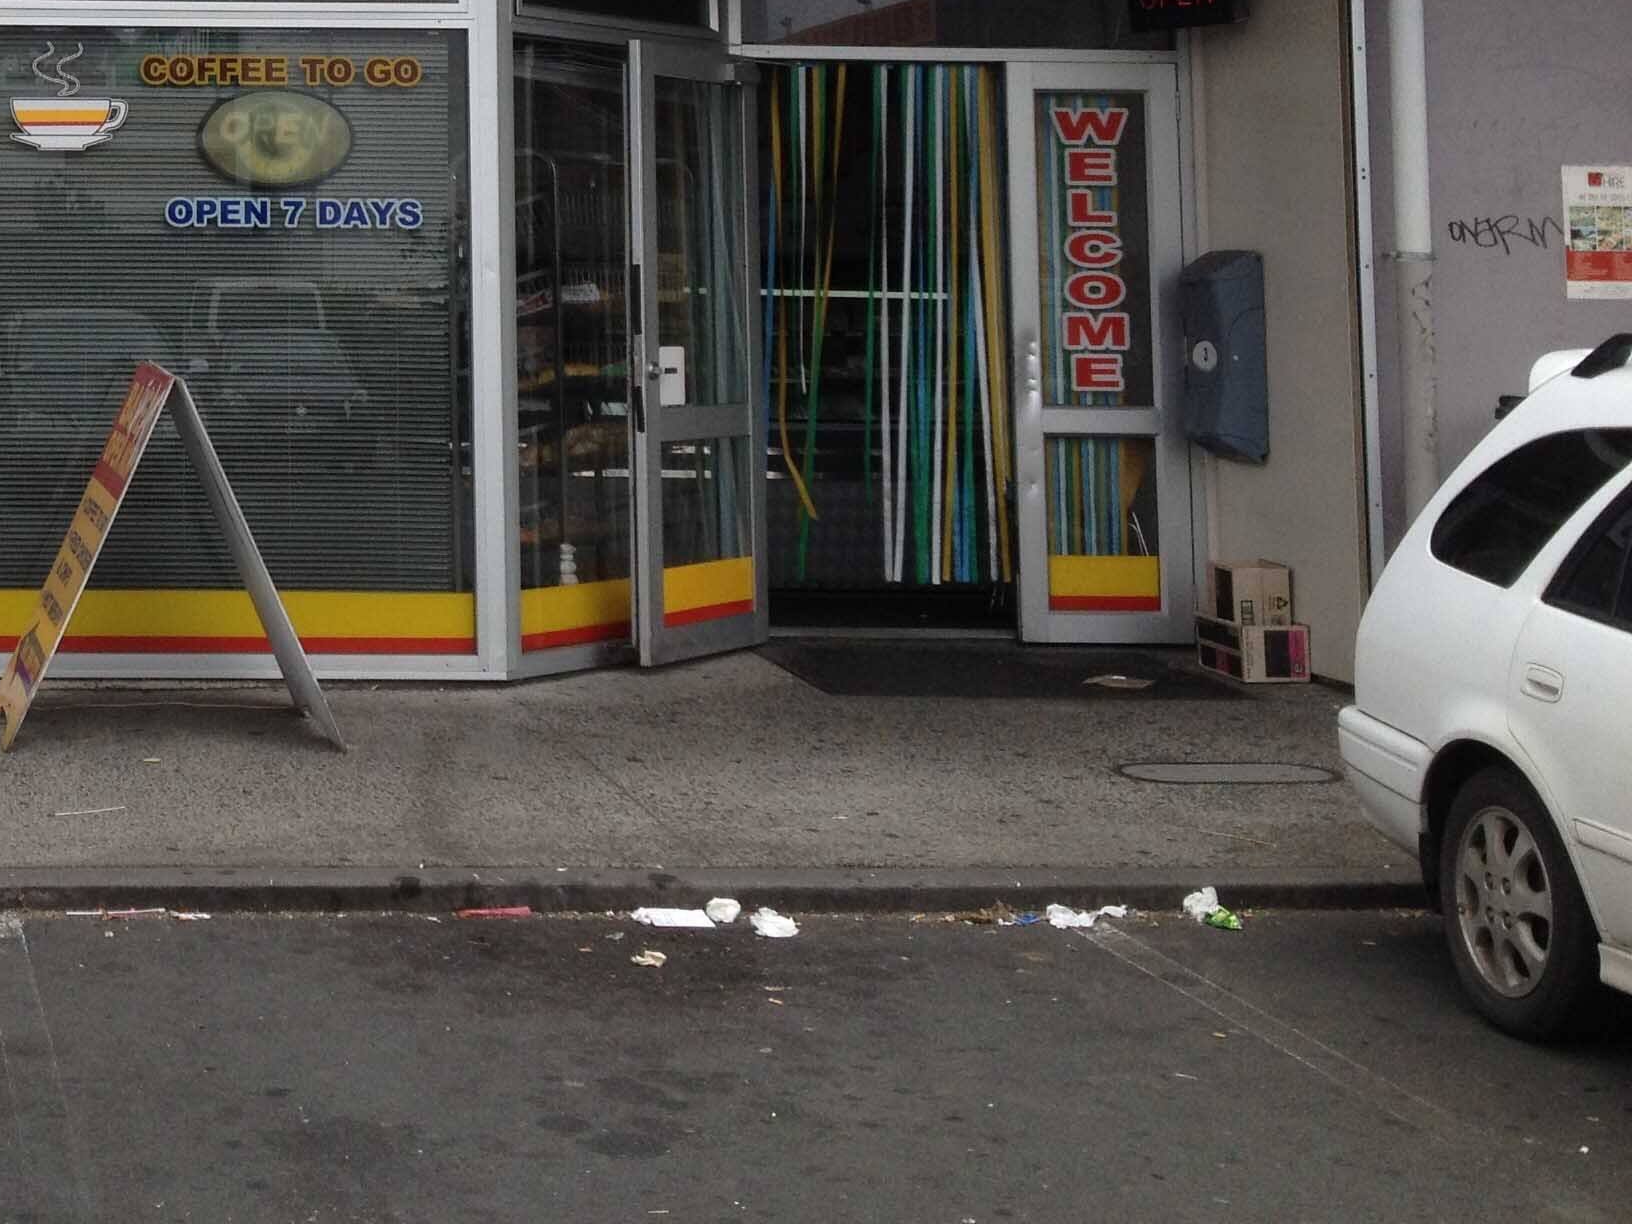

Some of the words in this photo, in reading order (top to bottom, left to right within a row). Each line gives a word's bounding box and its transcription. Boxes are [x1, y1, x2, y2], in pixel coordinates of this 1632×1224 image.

[140, 55, 288, 85] COFFEE
[301, 56, 355, 86] TO
[365, 57, 422, 87] GO
[165, 198, 270, 227] OPEN
[281, 199, 306, 228] 7
[315, 199, 424, 229] DAYS
[1051, 107, 1130, 392] WELCOME
